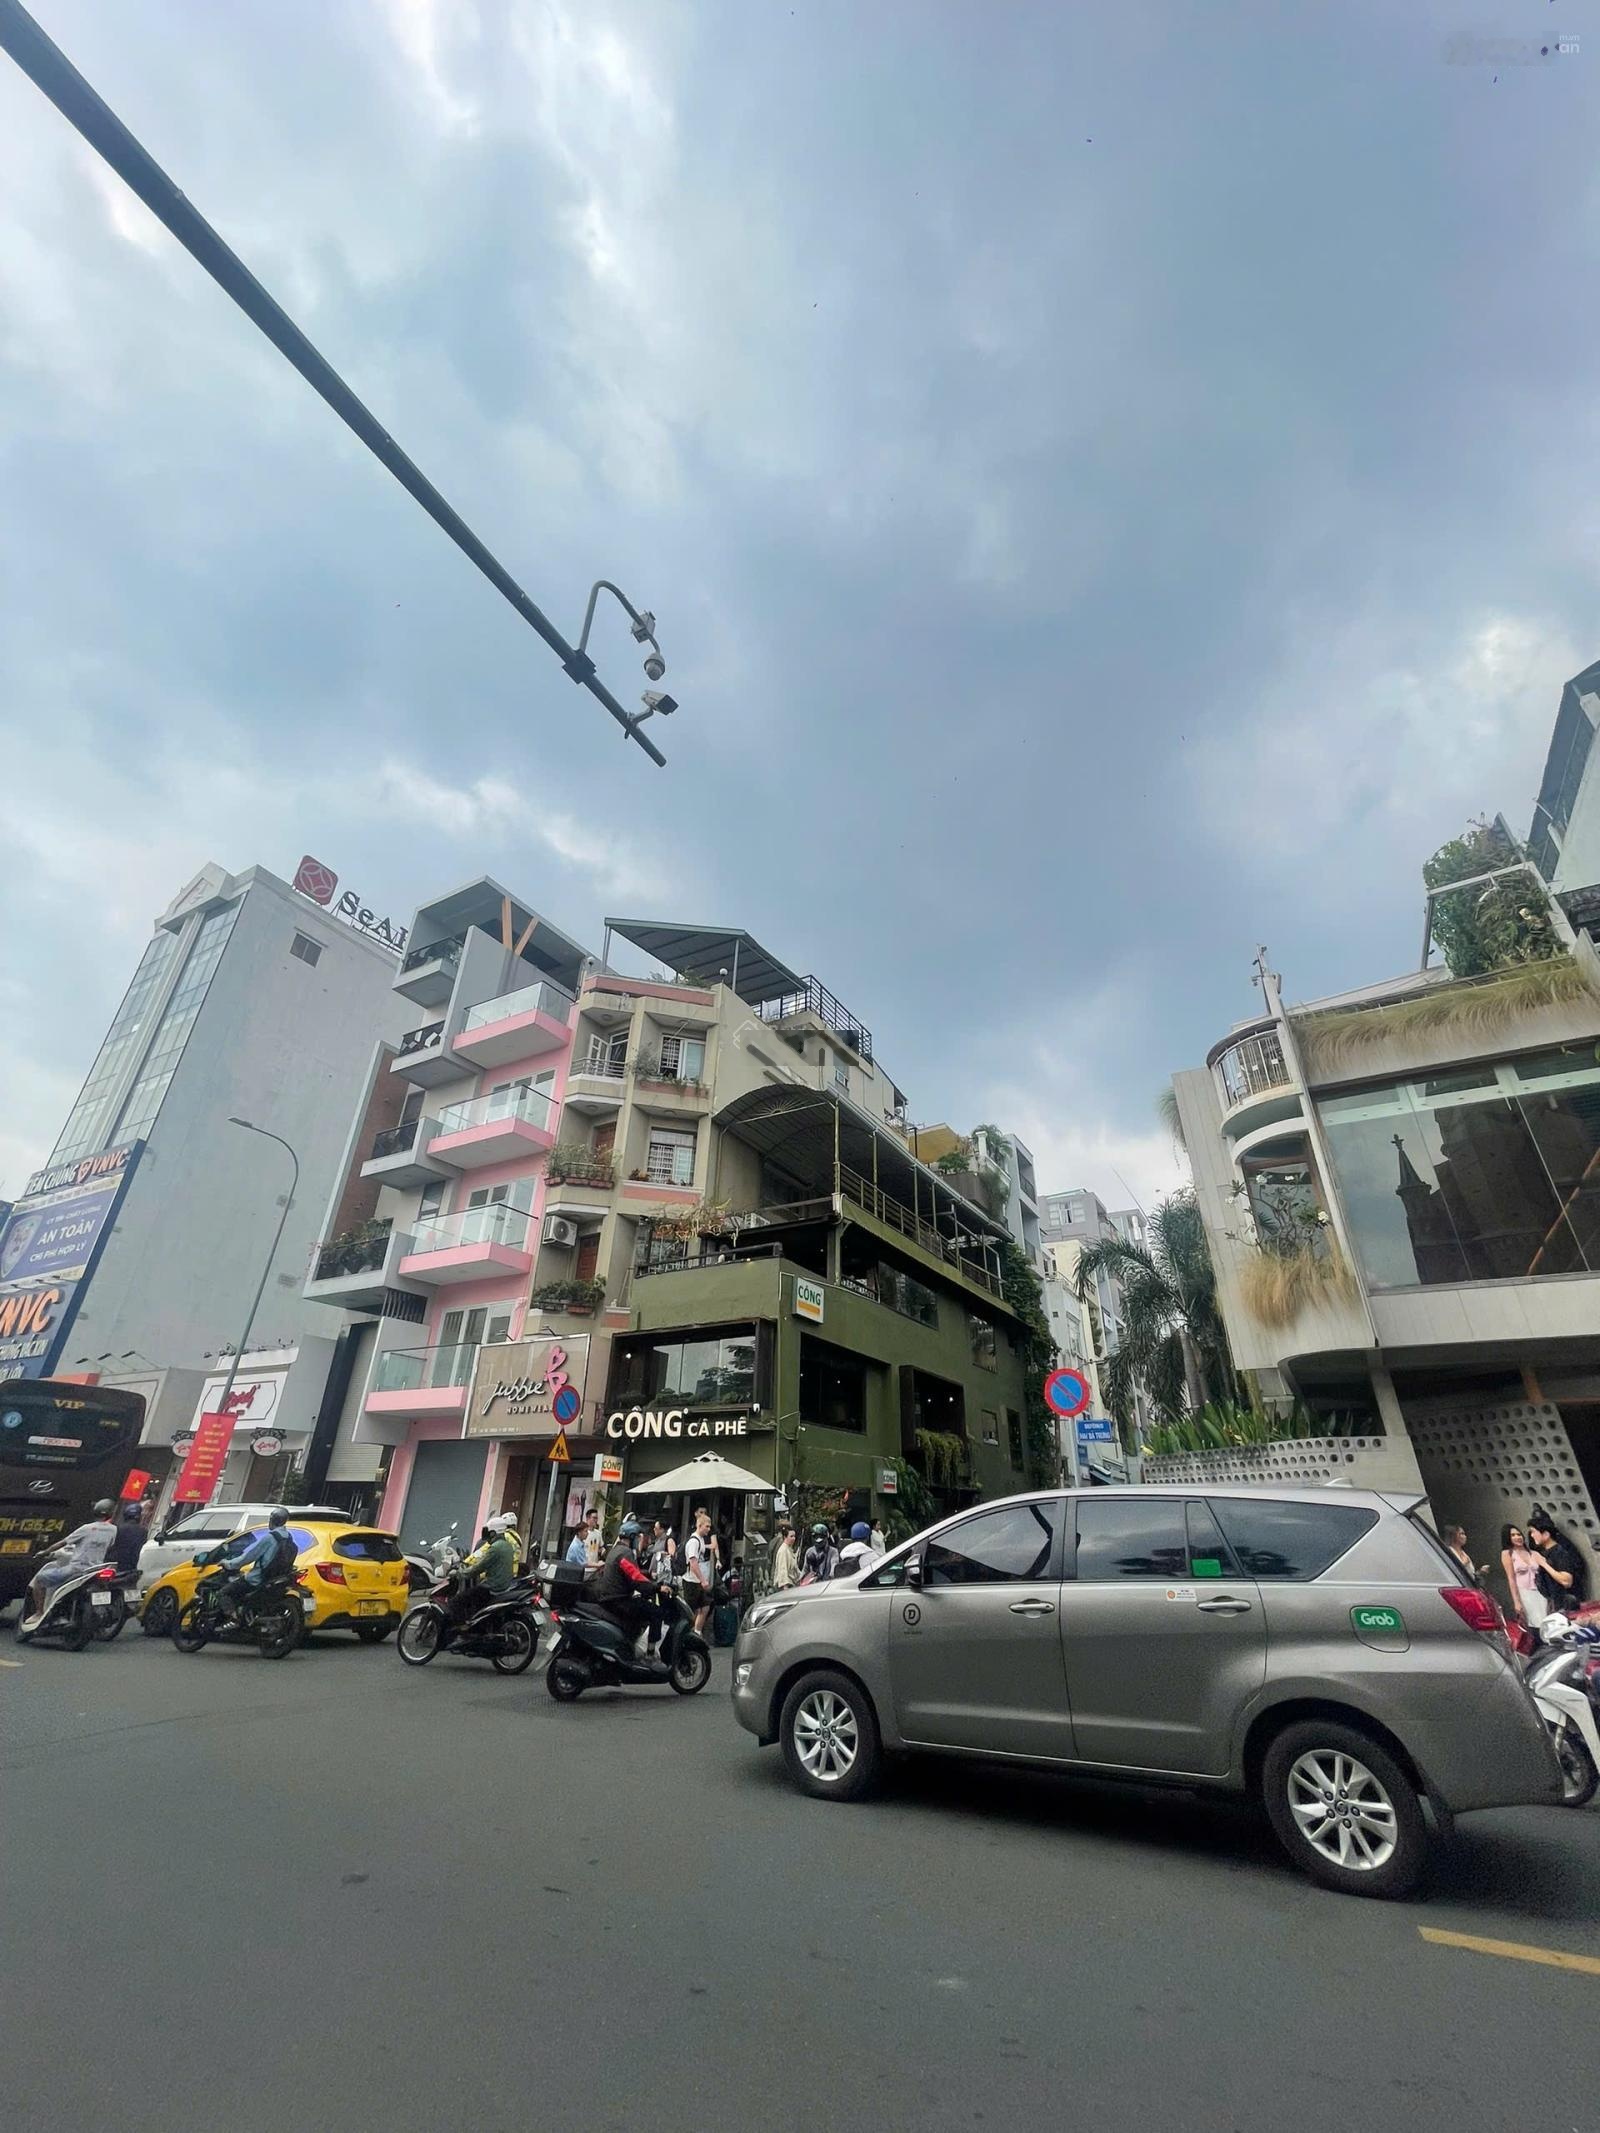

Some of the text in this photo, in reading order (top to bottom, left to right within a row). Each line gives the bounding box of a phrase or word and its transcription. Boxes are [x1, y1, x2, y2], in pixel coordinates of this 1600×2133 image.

[91, 1148, 129, 1175] VNVC
[53, 1399, 86, 1410] VIP
[606, 1405, 683, 1443] CỘNG
[714, 1416, 747, 1436] PHÊ
[1360, 1612, 1395, 1626] Grab
